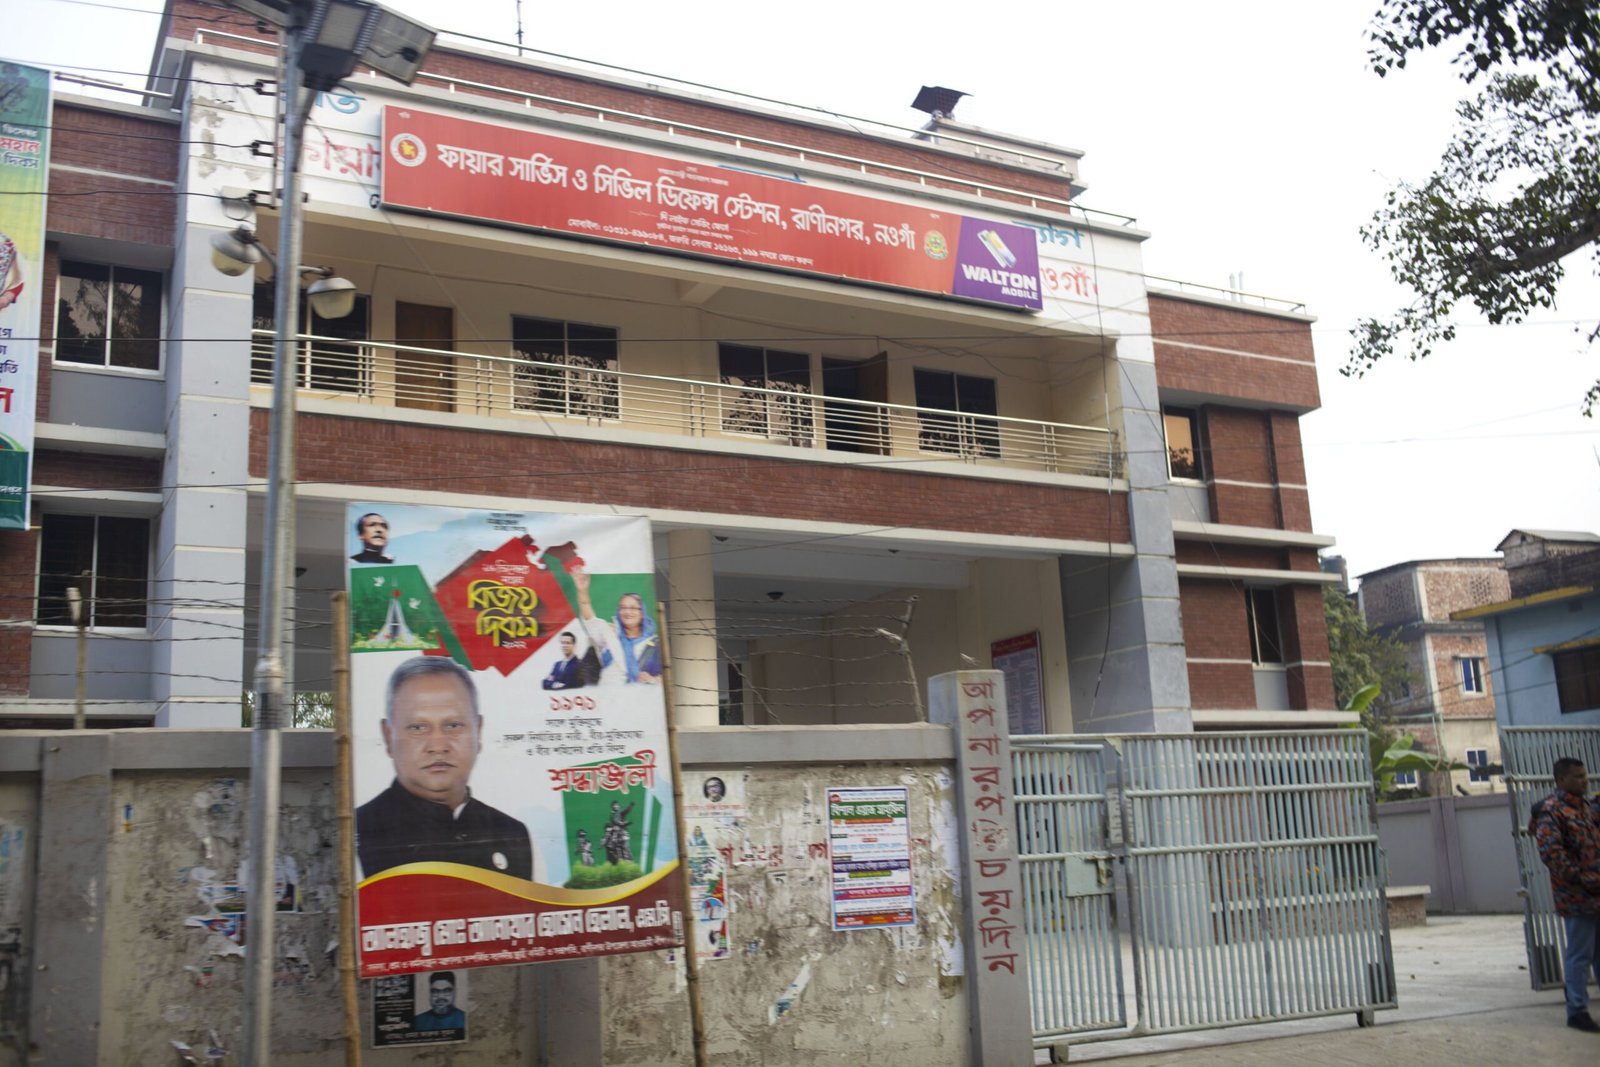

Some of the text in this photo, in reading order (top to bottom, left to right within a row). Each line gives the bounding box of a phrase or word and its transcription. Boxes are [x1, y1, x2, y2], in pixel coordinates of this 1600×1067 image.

[3, 151, 39, 169] দিবস
[436, 143, 504, 176] ফায়ার
[508, 152, 568, 188] সার্ভিস
[571, 168, 589, 191] ও
[593, 164, 652, 203] সিভিল
[656, 175, 719, 215] ডিফেন্স
[724, 191, 788, 231] স্টেশন,
[791, 204, 872, 245] রাণীনগর,
[874, 222, 916, 251] নওগাঁ
[961, 262, 1038, 292] WALTON
[1001, 285, 1039, 301] MOBILE
[467, 579, 539, 616] বিজয়
[475, 606, 538, 648] দিবস
[550, 695, 596, 711] ১৯৭১
[962, 678, 1003, 792] আপনার
[978, 916, 1019, 976] দিন
